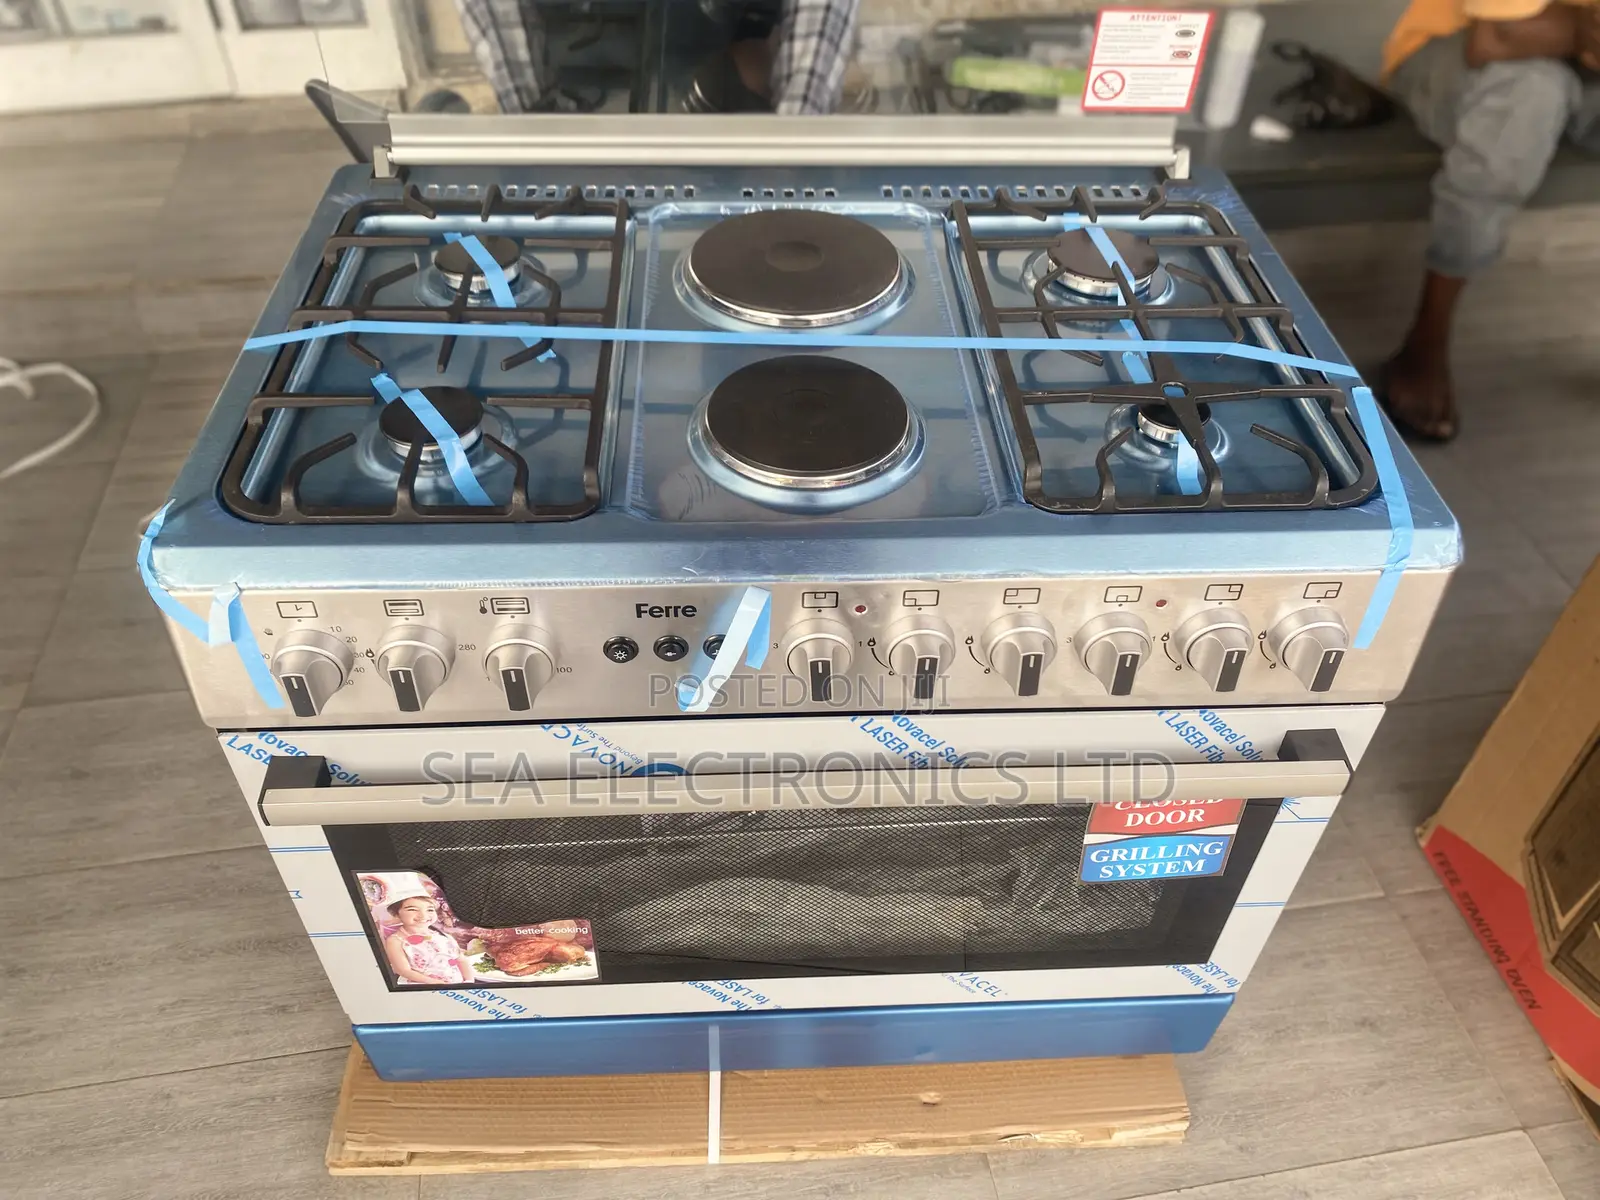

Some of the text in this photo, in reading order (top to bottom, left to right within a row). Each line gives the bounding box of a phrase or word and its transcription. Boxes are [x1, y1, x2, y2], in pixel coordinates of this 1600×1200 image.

[635, 603, 698, 619] Ferre
[330, 625, 342, 633] 10
[345, 636, 358, 644] 20
[458, 643, 477, 652] 280
[772, 642, 779, 650] 3
[1065, 636, 1072, 644] 3
[353, 651, 365, 659] 30
[353, 666, 366, 674] 40
[556, 666, 573, 674] 100
[860, 717, 909, 755] LASER
[1164, 712, 1209, 750] LASER
[598, 736, 614, 749] The
[614, 745, 643, 765] Beyond
[1124, 808, 1205, 827] DOOR
[1090, 841, 1224, 863] GRILLING
[1099, 858, 1206, 879] SYSTEM
[514, 926, 588, 935] better cooking
[1457, 890, 1510, 964] STANDING
[1506, 969, 1543, 1011] OVEN
[1198, 961, 1241, 989] for LASE
[714, 980, 770, 1005] for LASE
[959, 972, 1002, 997] VACEL
[465, 989, 528, 1014] for LASE
